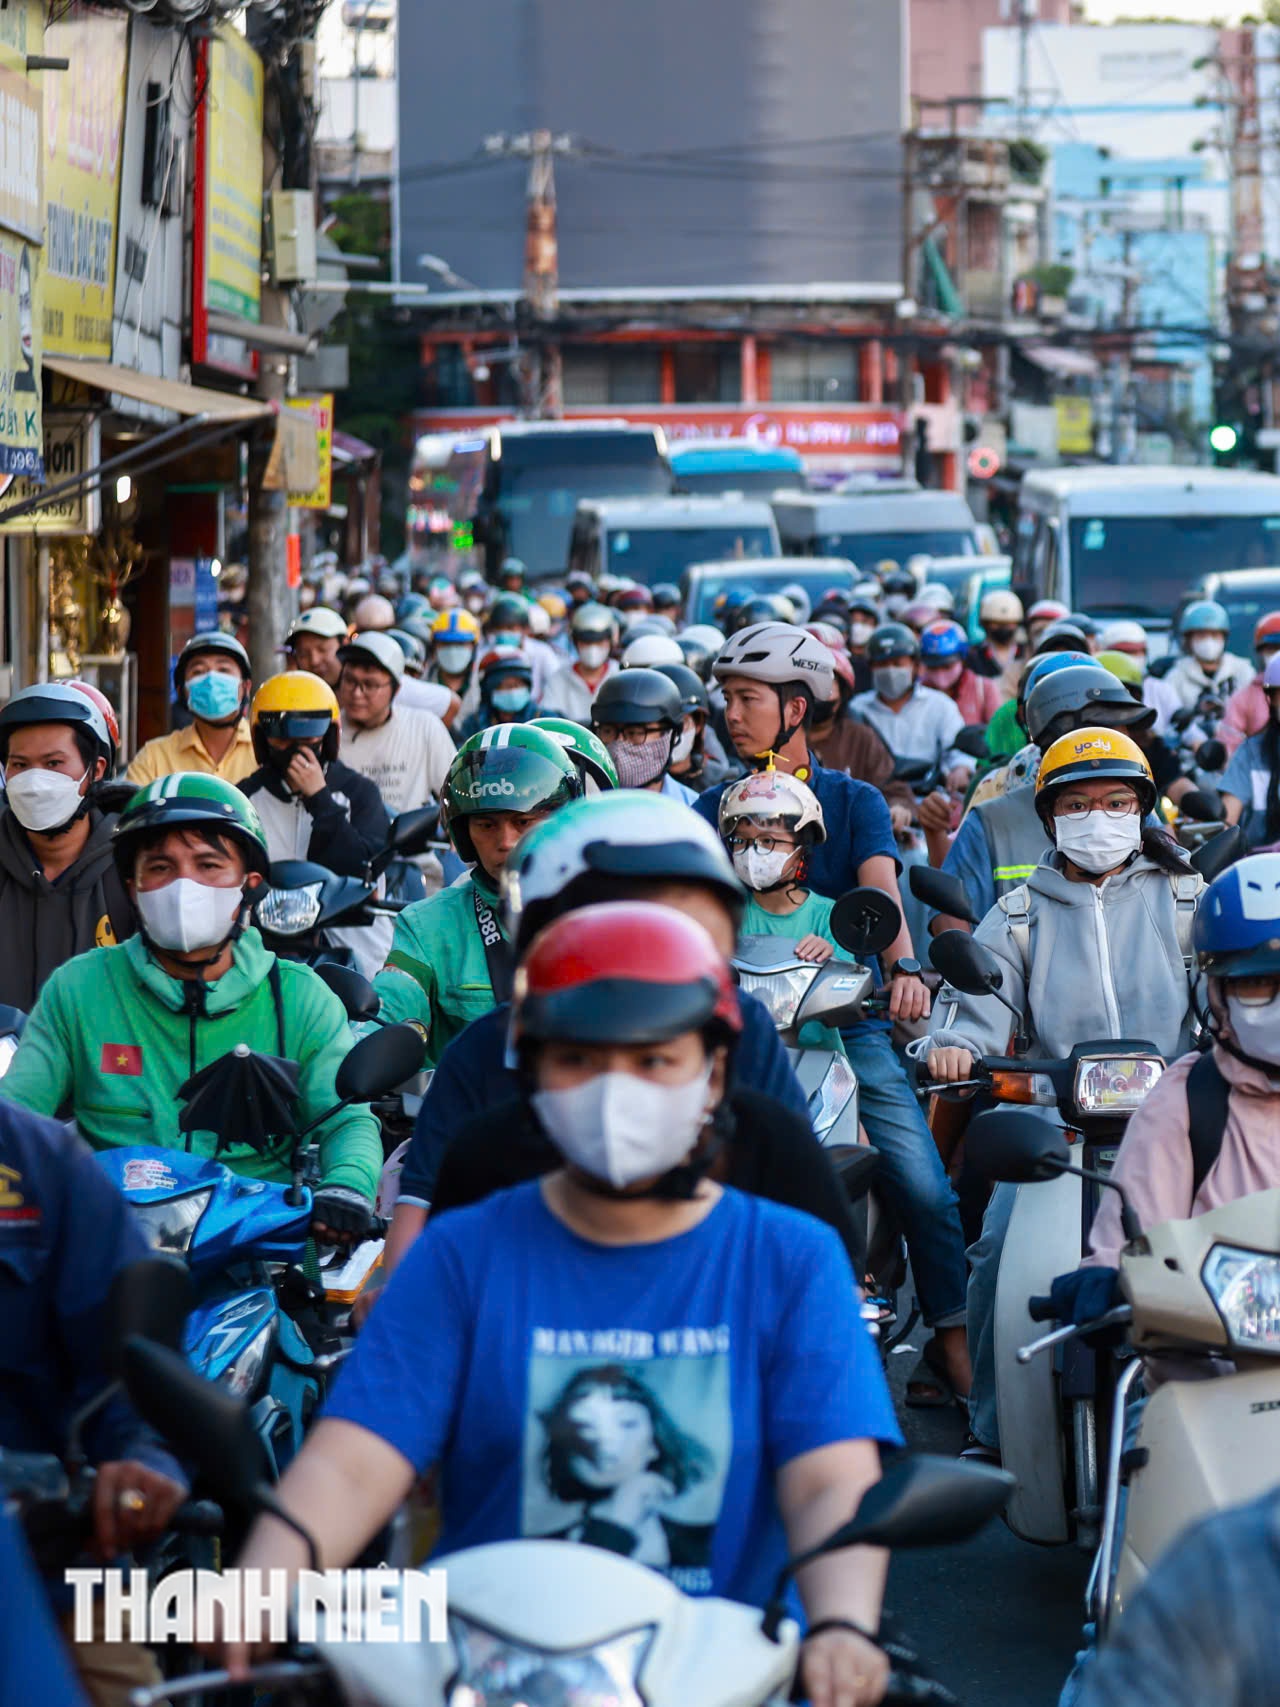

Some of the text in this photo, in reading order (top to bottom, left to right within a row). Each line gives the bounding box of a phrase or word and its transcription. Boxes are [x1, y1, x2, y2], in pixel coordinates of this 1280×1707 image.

[792, 657, 819, 671] WEST
[1074, 738, 1113, 754] yody
[469, 778, 515, 798] Grab
